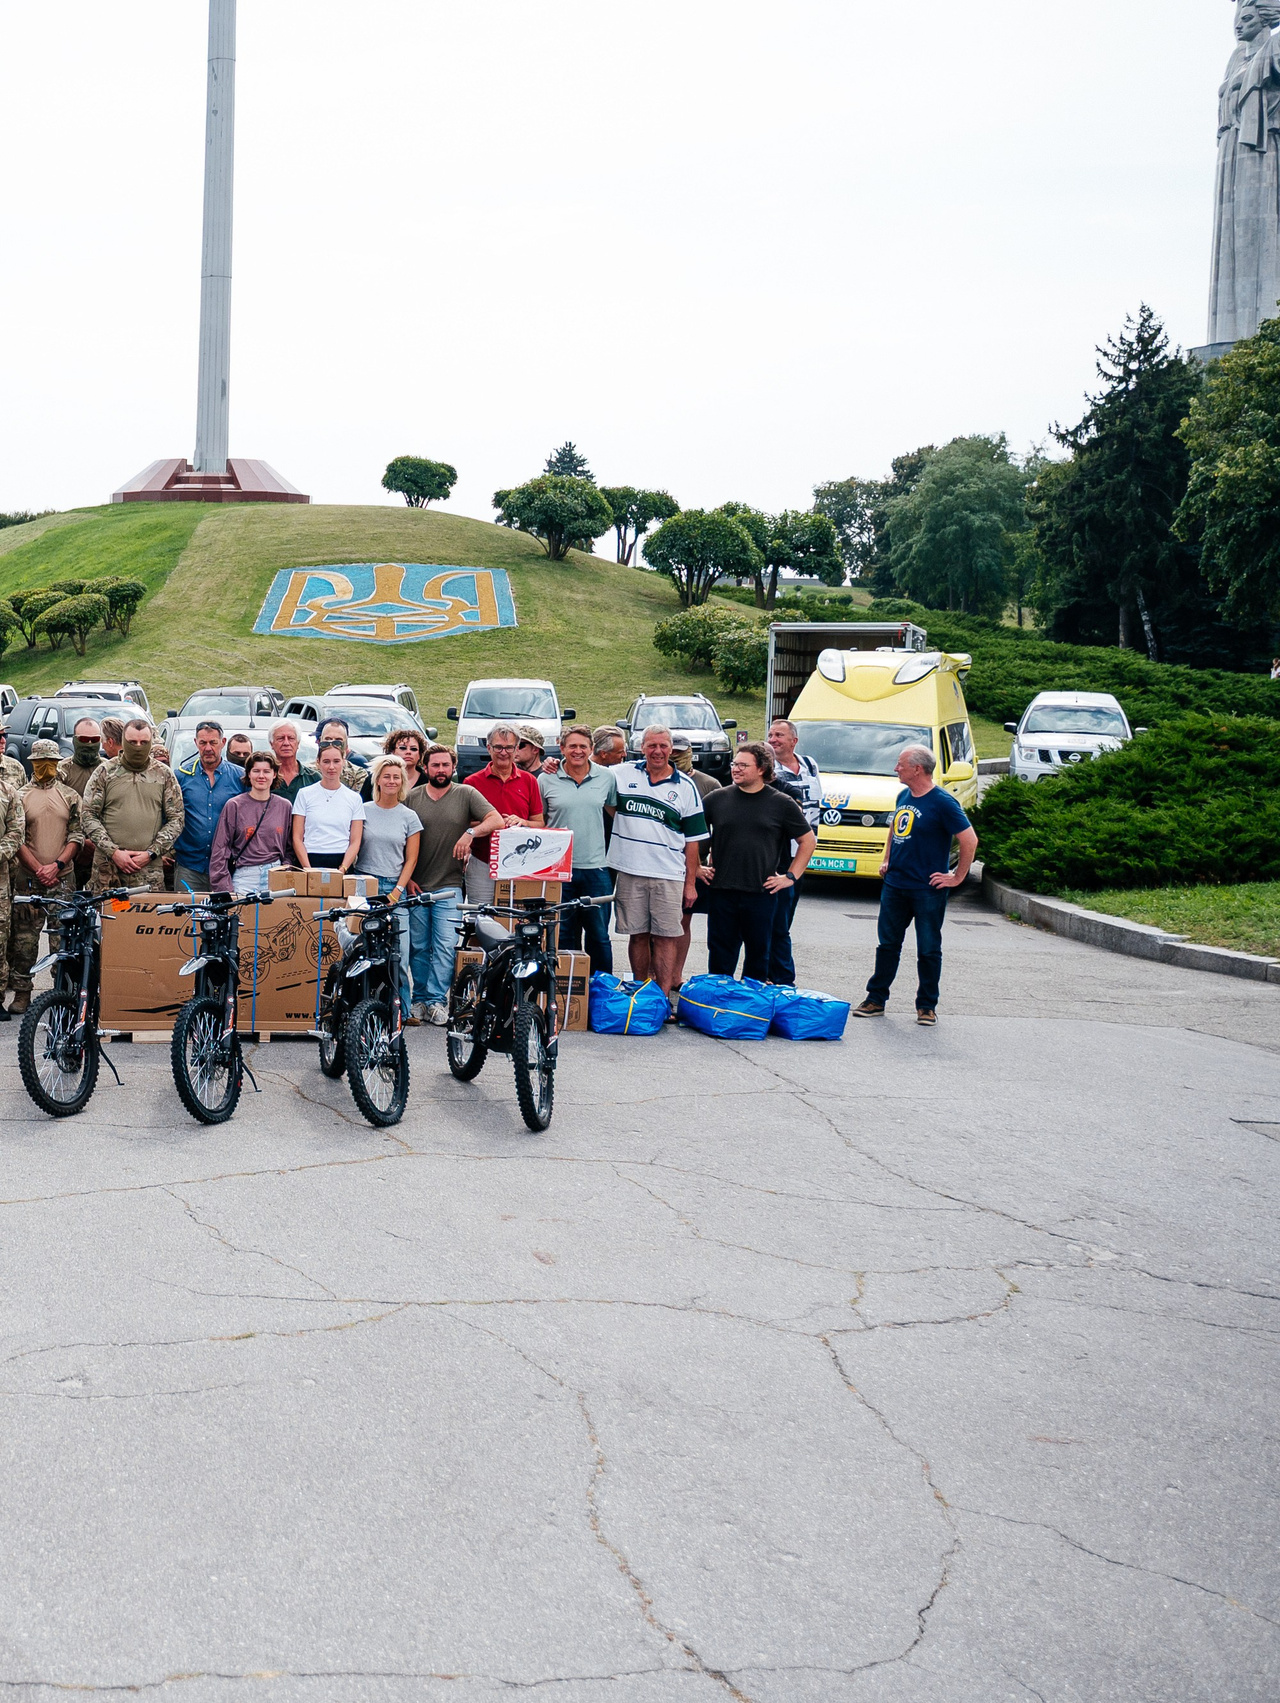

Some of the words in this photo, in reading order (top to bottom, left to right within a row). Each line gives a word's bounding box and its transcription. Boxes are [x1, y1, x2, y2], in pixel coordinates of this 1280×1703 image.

[489, 830, 500, 879] DOLMAR
[135, 925, 154, 935] Go
[158, 925, 180, 935] for
